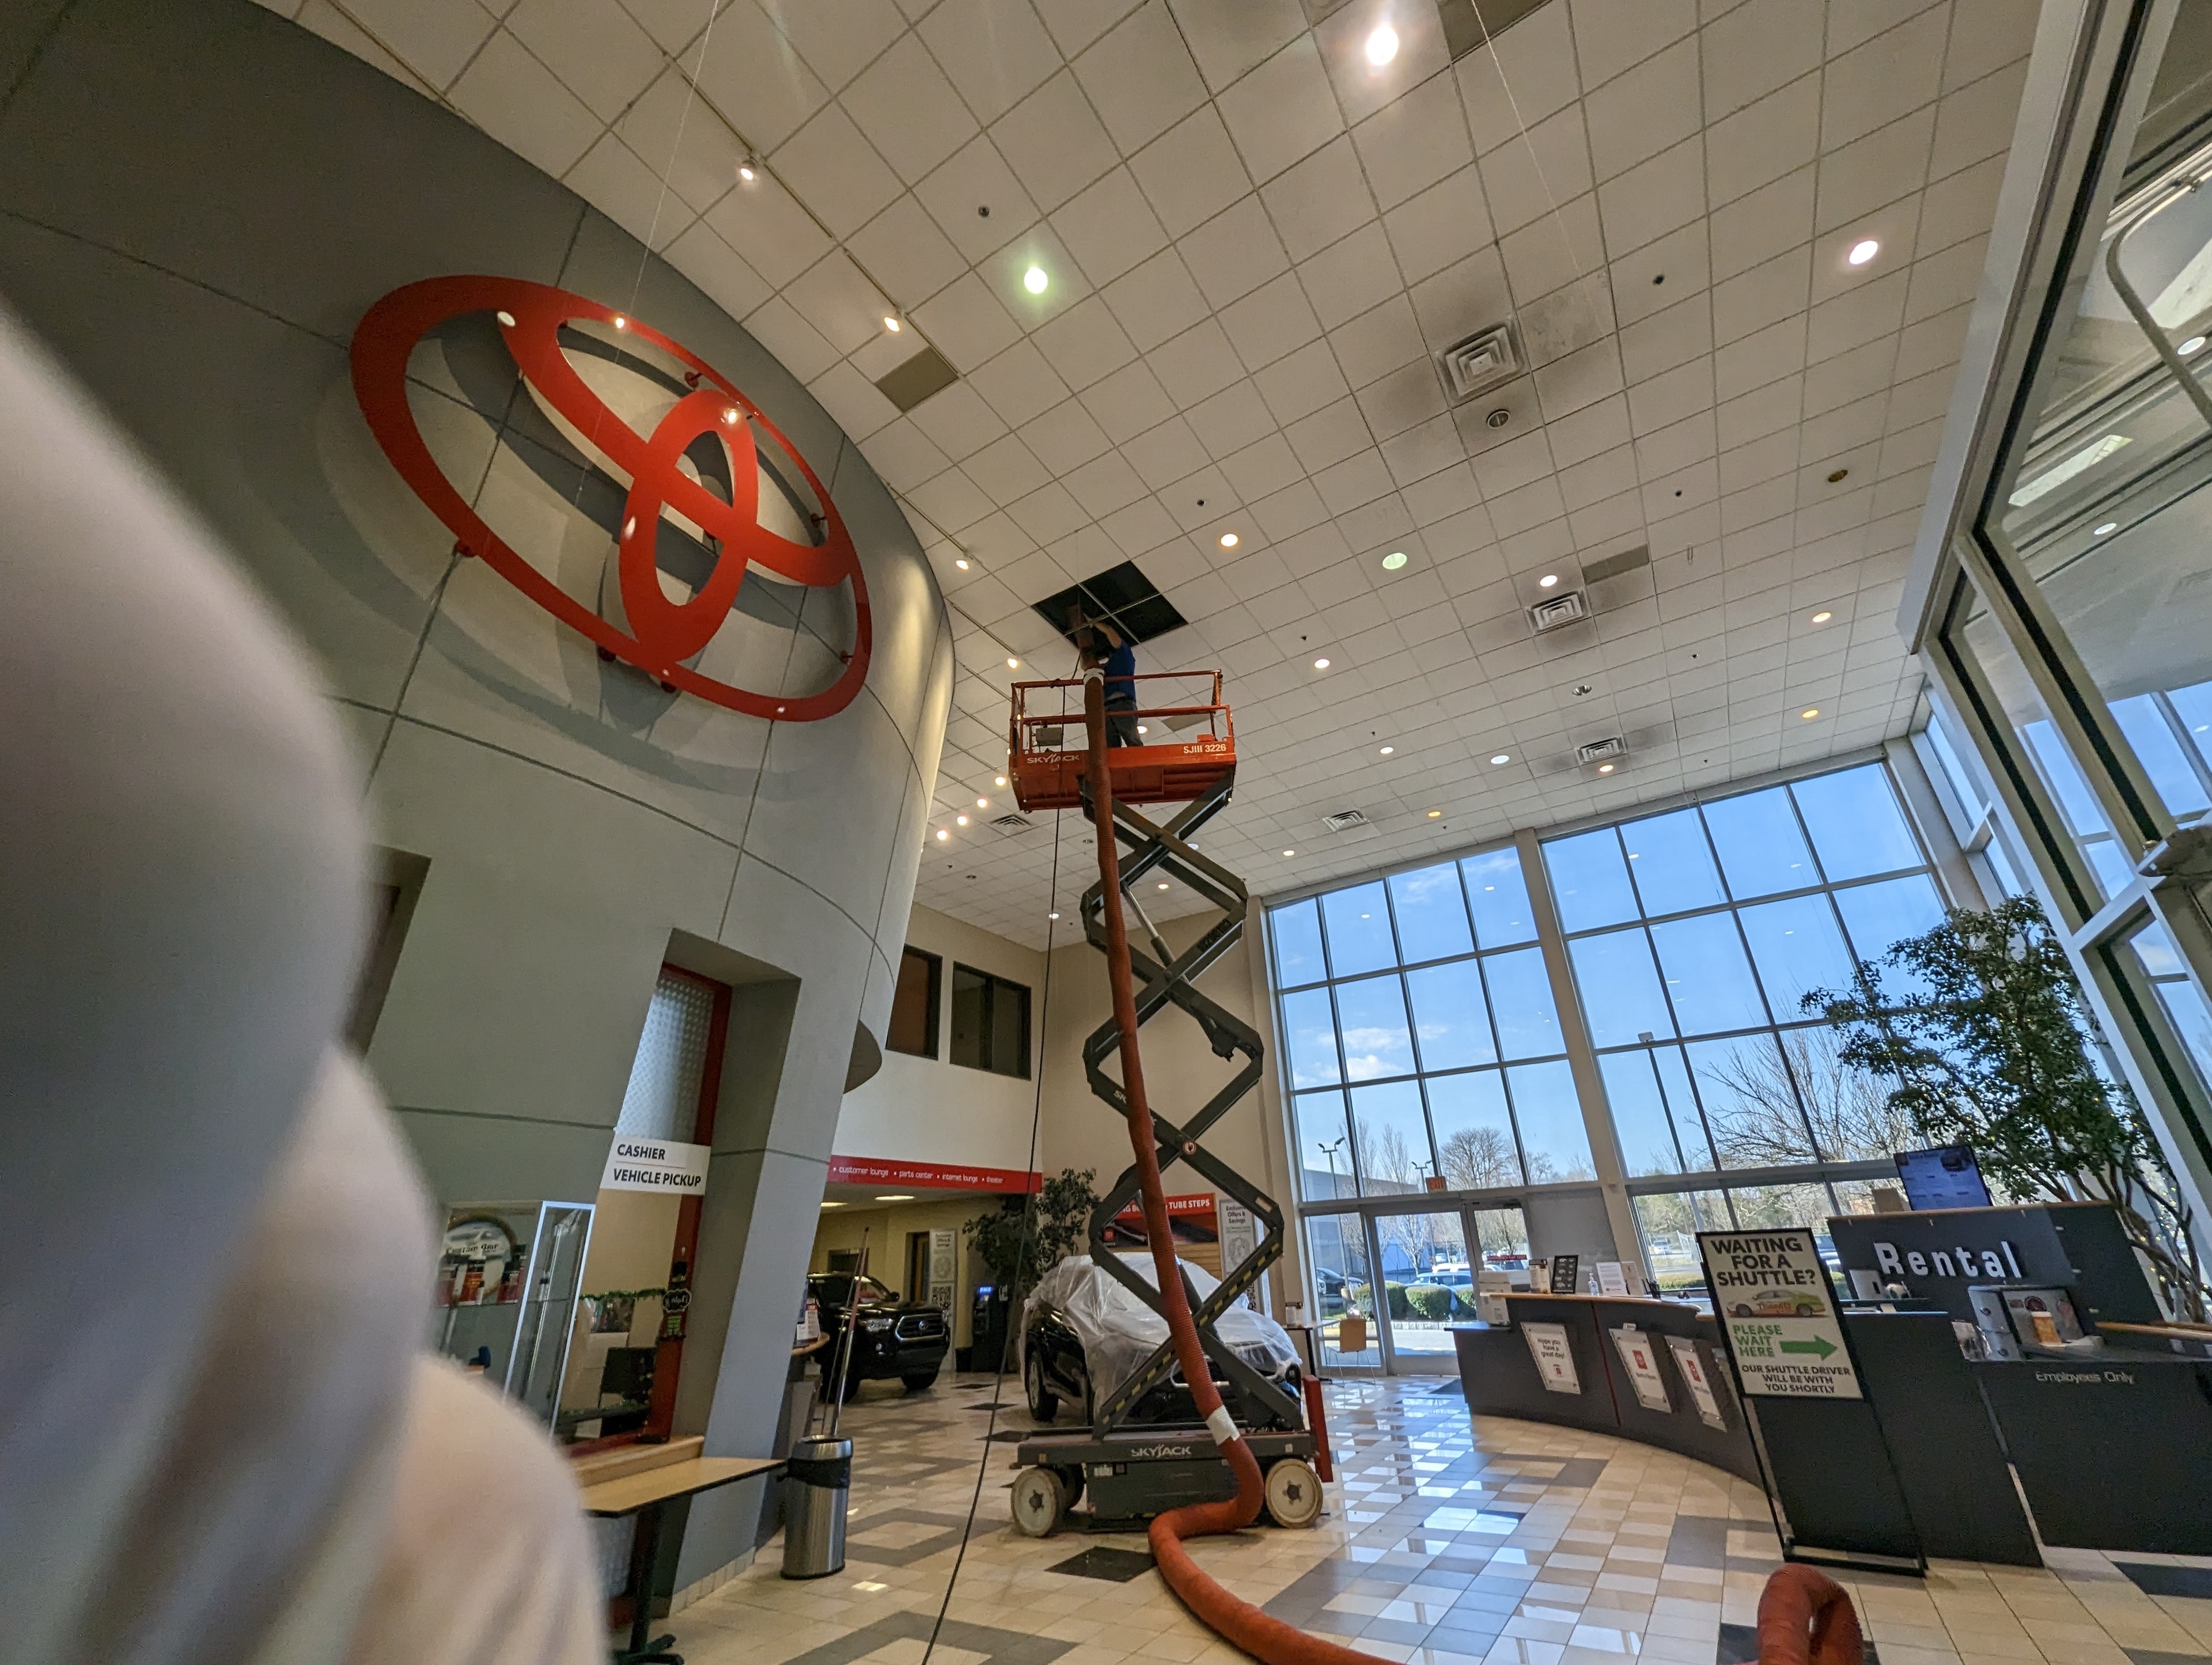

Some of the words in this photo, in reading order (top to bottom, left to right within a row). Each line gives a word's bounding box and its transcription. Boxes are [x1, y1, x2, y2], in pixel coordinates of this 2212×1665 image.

[1205, 744, 1226, 752] 3226
[1027, 753, 1080, 764] SKYJACK
[617, 1144, 666, 1160] CASHIER
[839, 1166, 869, 1174] customer
[870, 1167, 888, 1178] lounge
[899, 1170, 914, 1178] parts
[613, 1169, 661, 1184] VEHICLE
[663, 1173, 702, 1187] PICKUP
[963, 1174, 978, 1184] lounge
[1169, 1201, 1187, 1209] TUBE
[1188, 1199, 1210, 1208] STEPS
[1710, 1237, 1803, 1254] WAITING
[1731, 1254, 1774, 1270] FOR
[1777, 1253, 1793, 1269] A
[1873, 1241, 2022, 1278] Rental
[1717, 1269, 1816, 1286] SHUTTLE?
[1732, 1325, 1783, 1335] PLEASE
[1734, 1336, 1771, 1347] WAIT
[1738, 1347, 1775, 1357] HERE
[1741, 1365, 1764, 1373] OUR
[1766, 1365, 1809, 1374] SHUTTLE
[1812, 1366, 1851, 1375] DRIVER
[1762, 1374, 1788, 1383] WILL
[1789, 1374, 1804, 1383] BE
[1805, 1375, 1834, 1384] WITH
[2036, 1370, 2101, 1384] Employees
[2103, 1371, 2134, 1385] Only
[1765, 1383, 1787, 1392] YOU
[1789, 1384, 1835, 1394] SHORTLY
[1131, 1444, 1191, 1458] SKYJACK
